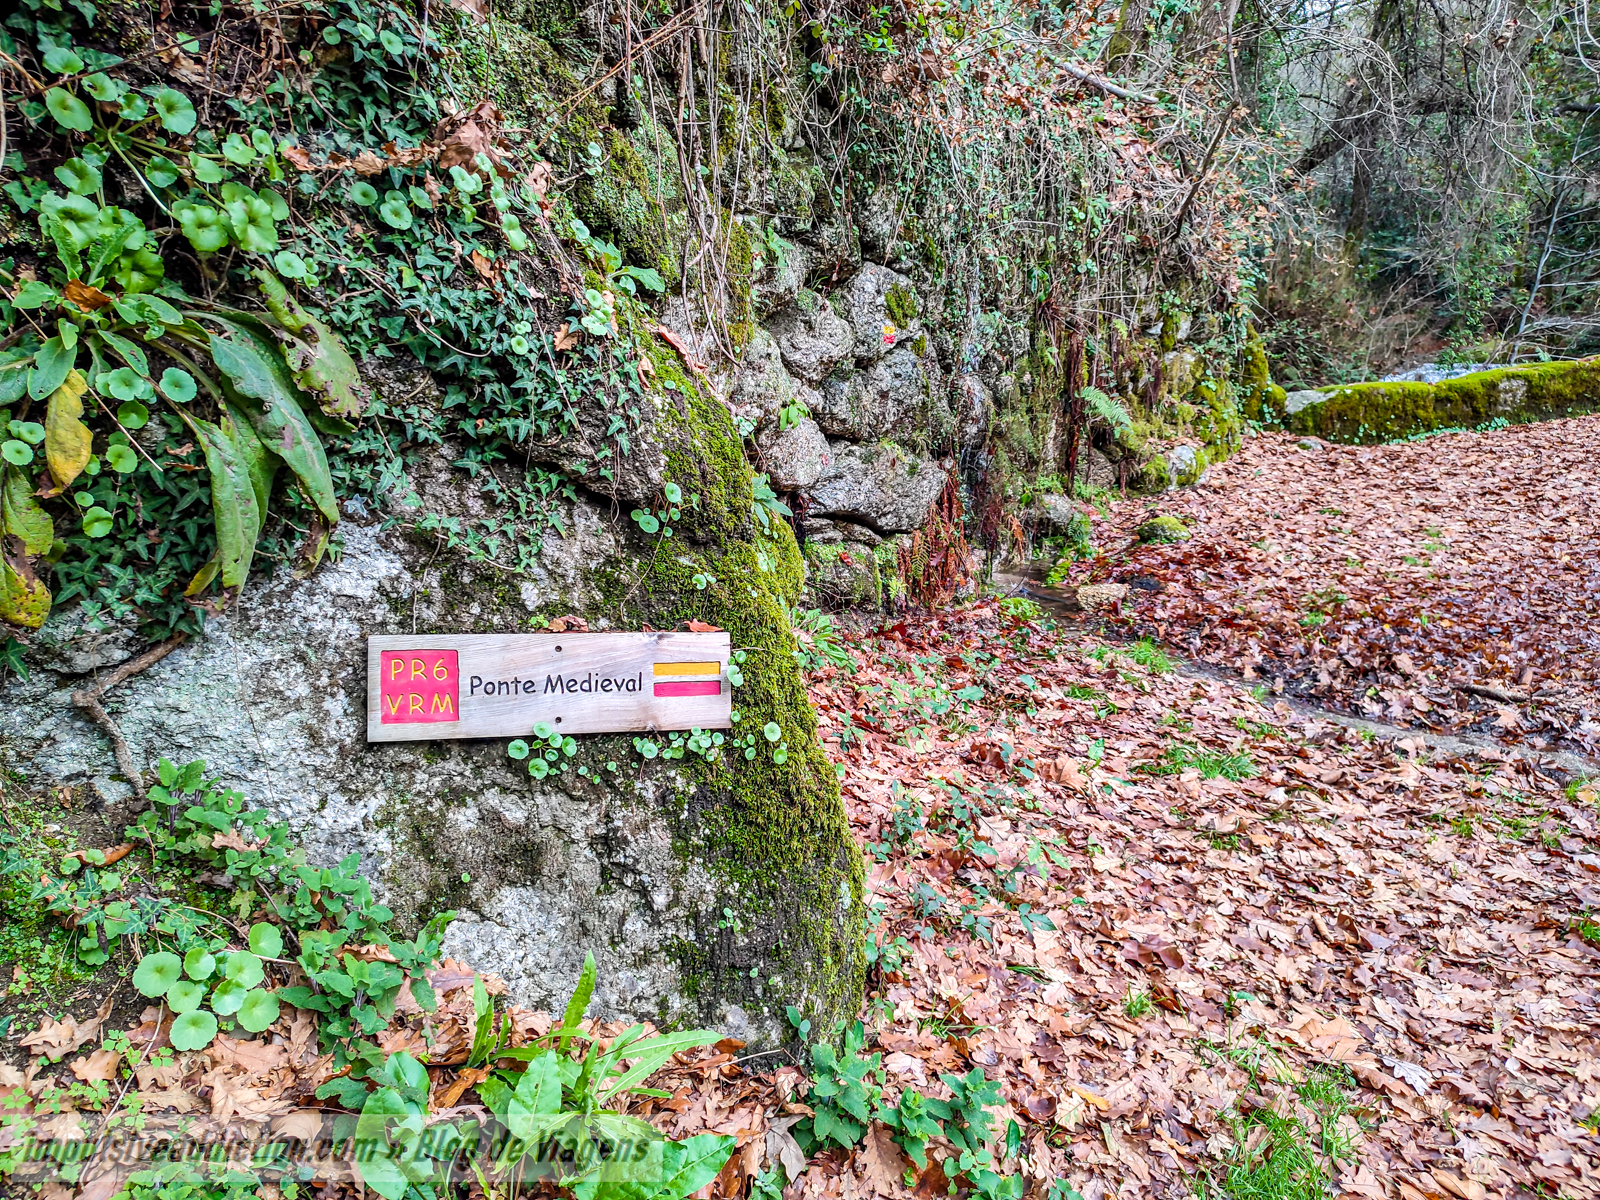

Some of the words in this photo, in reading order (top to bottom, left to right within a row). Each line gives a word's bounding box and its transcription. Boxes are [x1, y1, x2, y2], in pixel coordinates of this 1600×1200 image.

[390, 658, 449, 681] PR6
[469, 675, 536, 696] Ponte
[543, 671, 643, 695] Medieval
[386, 692, 454, 715] VRM
